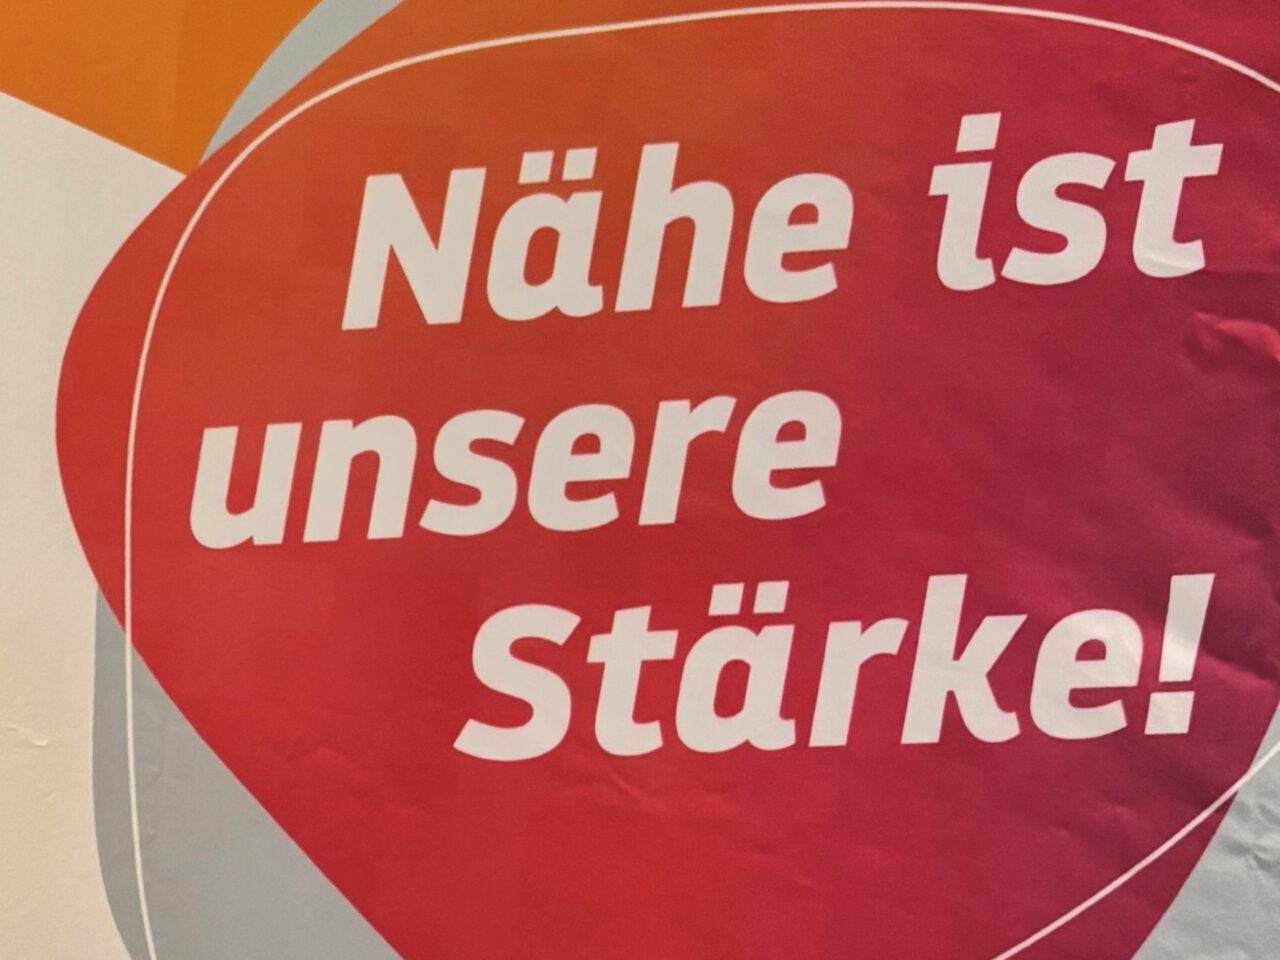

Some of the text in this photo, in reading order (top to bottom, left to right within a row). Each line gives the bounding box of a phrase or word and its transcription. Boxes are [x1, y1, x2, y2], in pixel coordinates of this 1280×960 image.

[342, 113, 1223, 329] Nähe ist
[191, 391, 841, 548] unsere
[454, 574, 1214, 761] Stärke!
